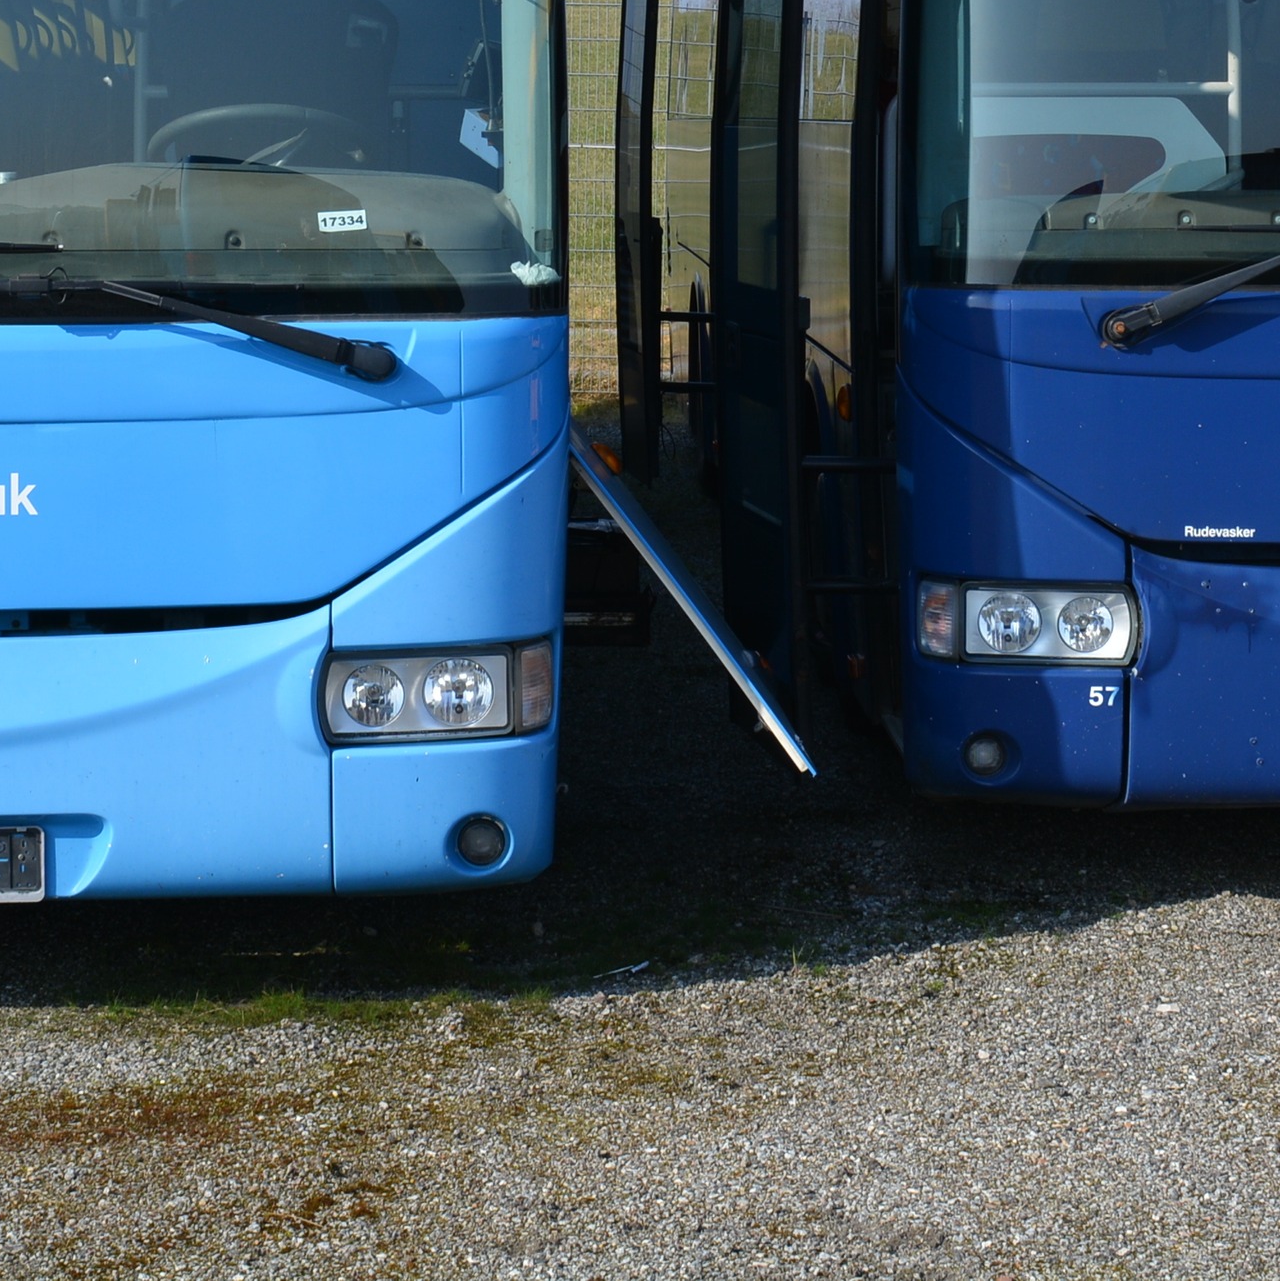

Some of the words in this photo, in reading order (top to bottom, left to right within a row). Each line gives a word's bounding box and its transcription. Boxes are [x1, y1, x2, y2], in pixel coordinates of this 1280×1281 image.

[320, 215, 365, 227] 17334
[1184, 525, 1256, 539] Rudevasker
[1088, 686, 1120, 707] 57
